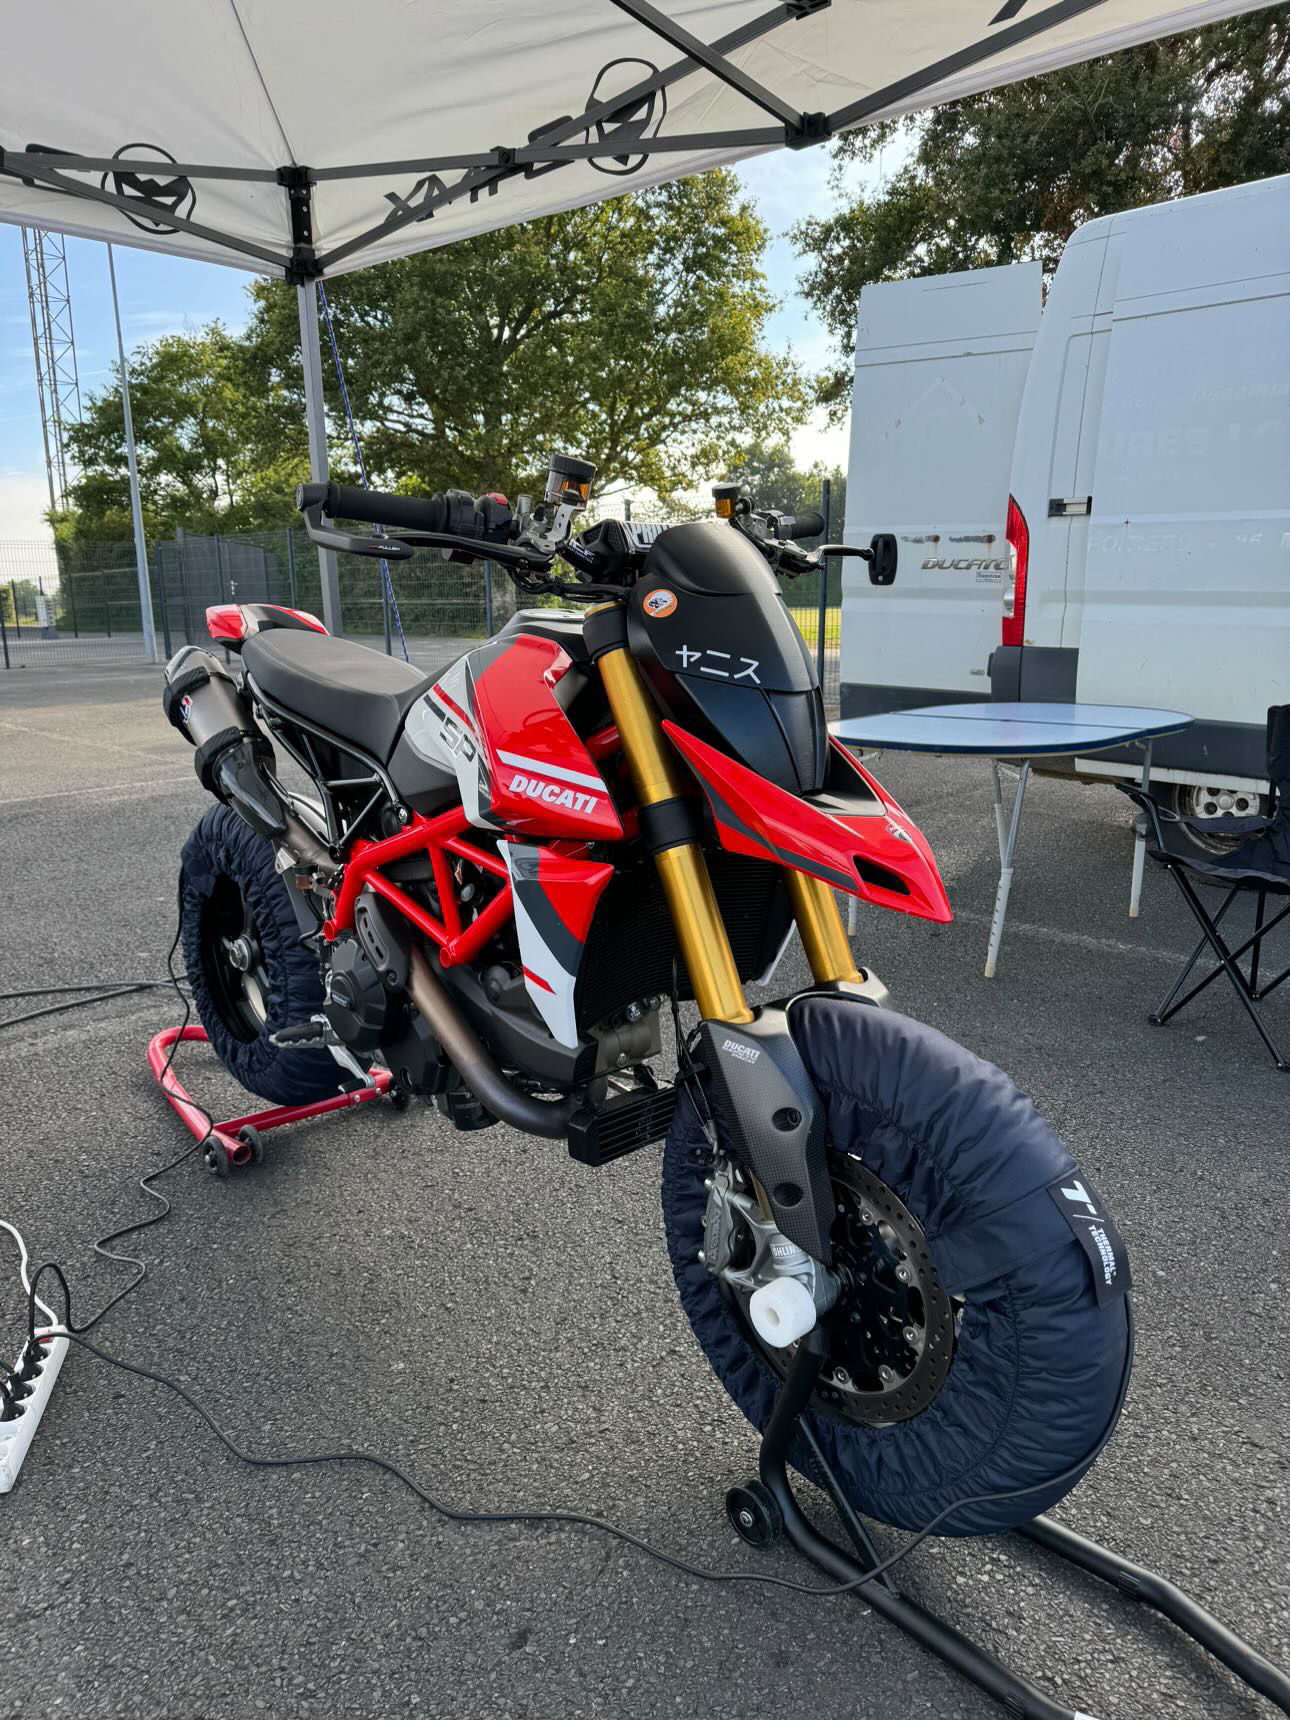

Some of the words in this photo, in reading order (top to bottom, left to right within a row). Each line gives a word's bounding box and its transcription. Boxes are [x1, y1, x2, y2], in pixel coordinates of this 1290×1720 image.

[675, 644, 761, 685] ヤニス
[509, 774, 598, 815] DUCATI
[722, 1039, 761, 1058] DUCATI
[1088, 1225, 1112, 1285] TECHNOLOGY
[1098, 1227, 1116, 1273] THERMAL
